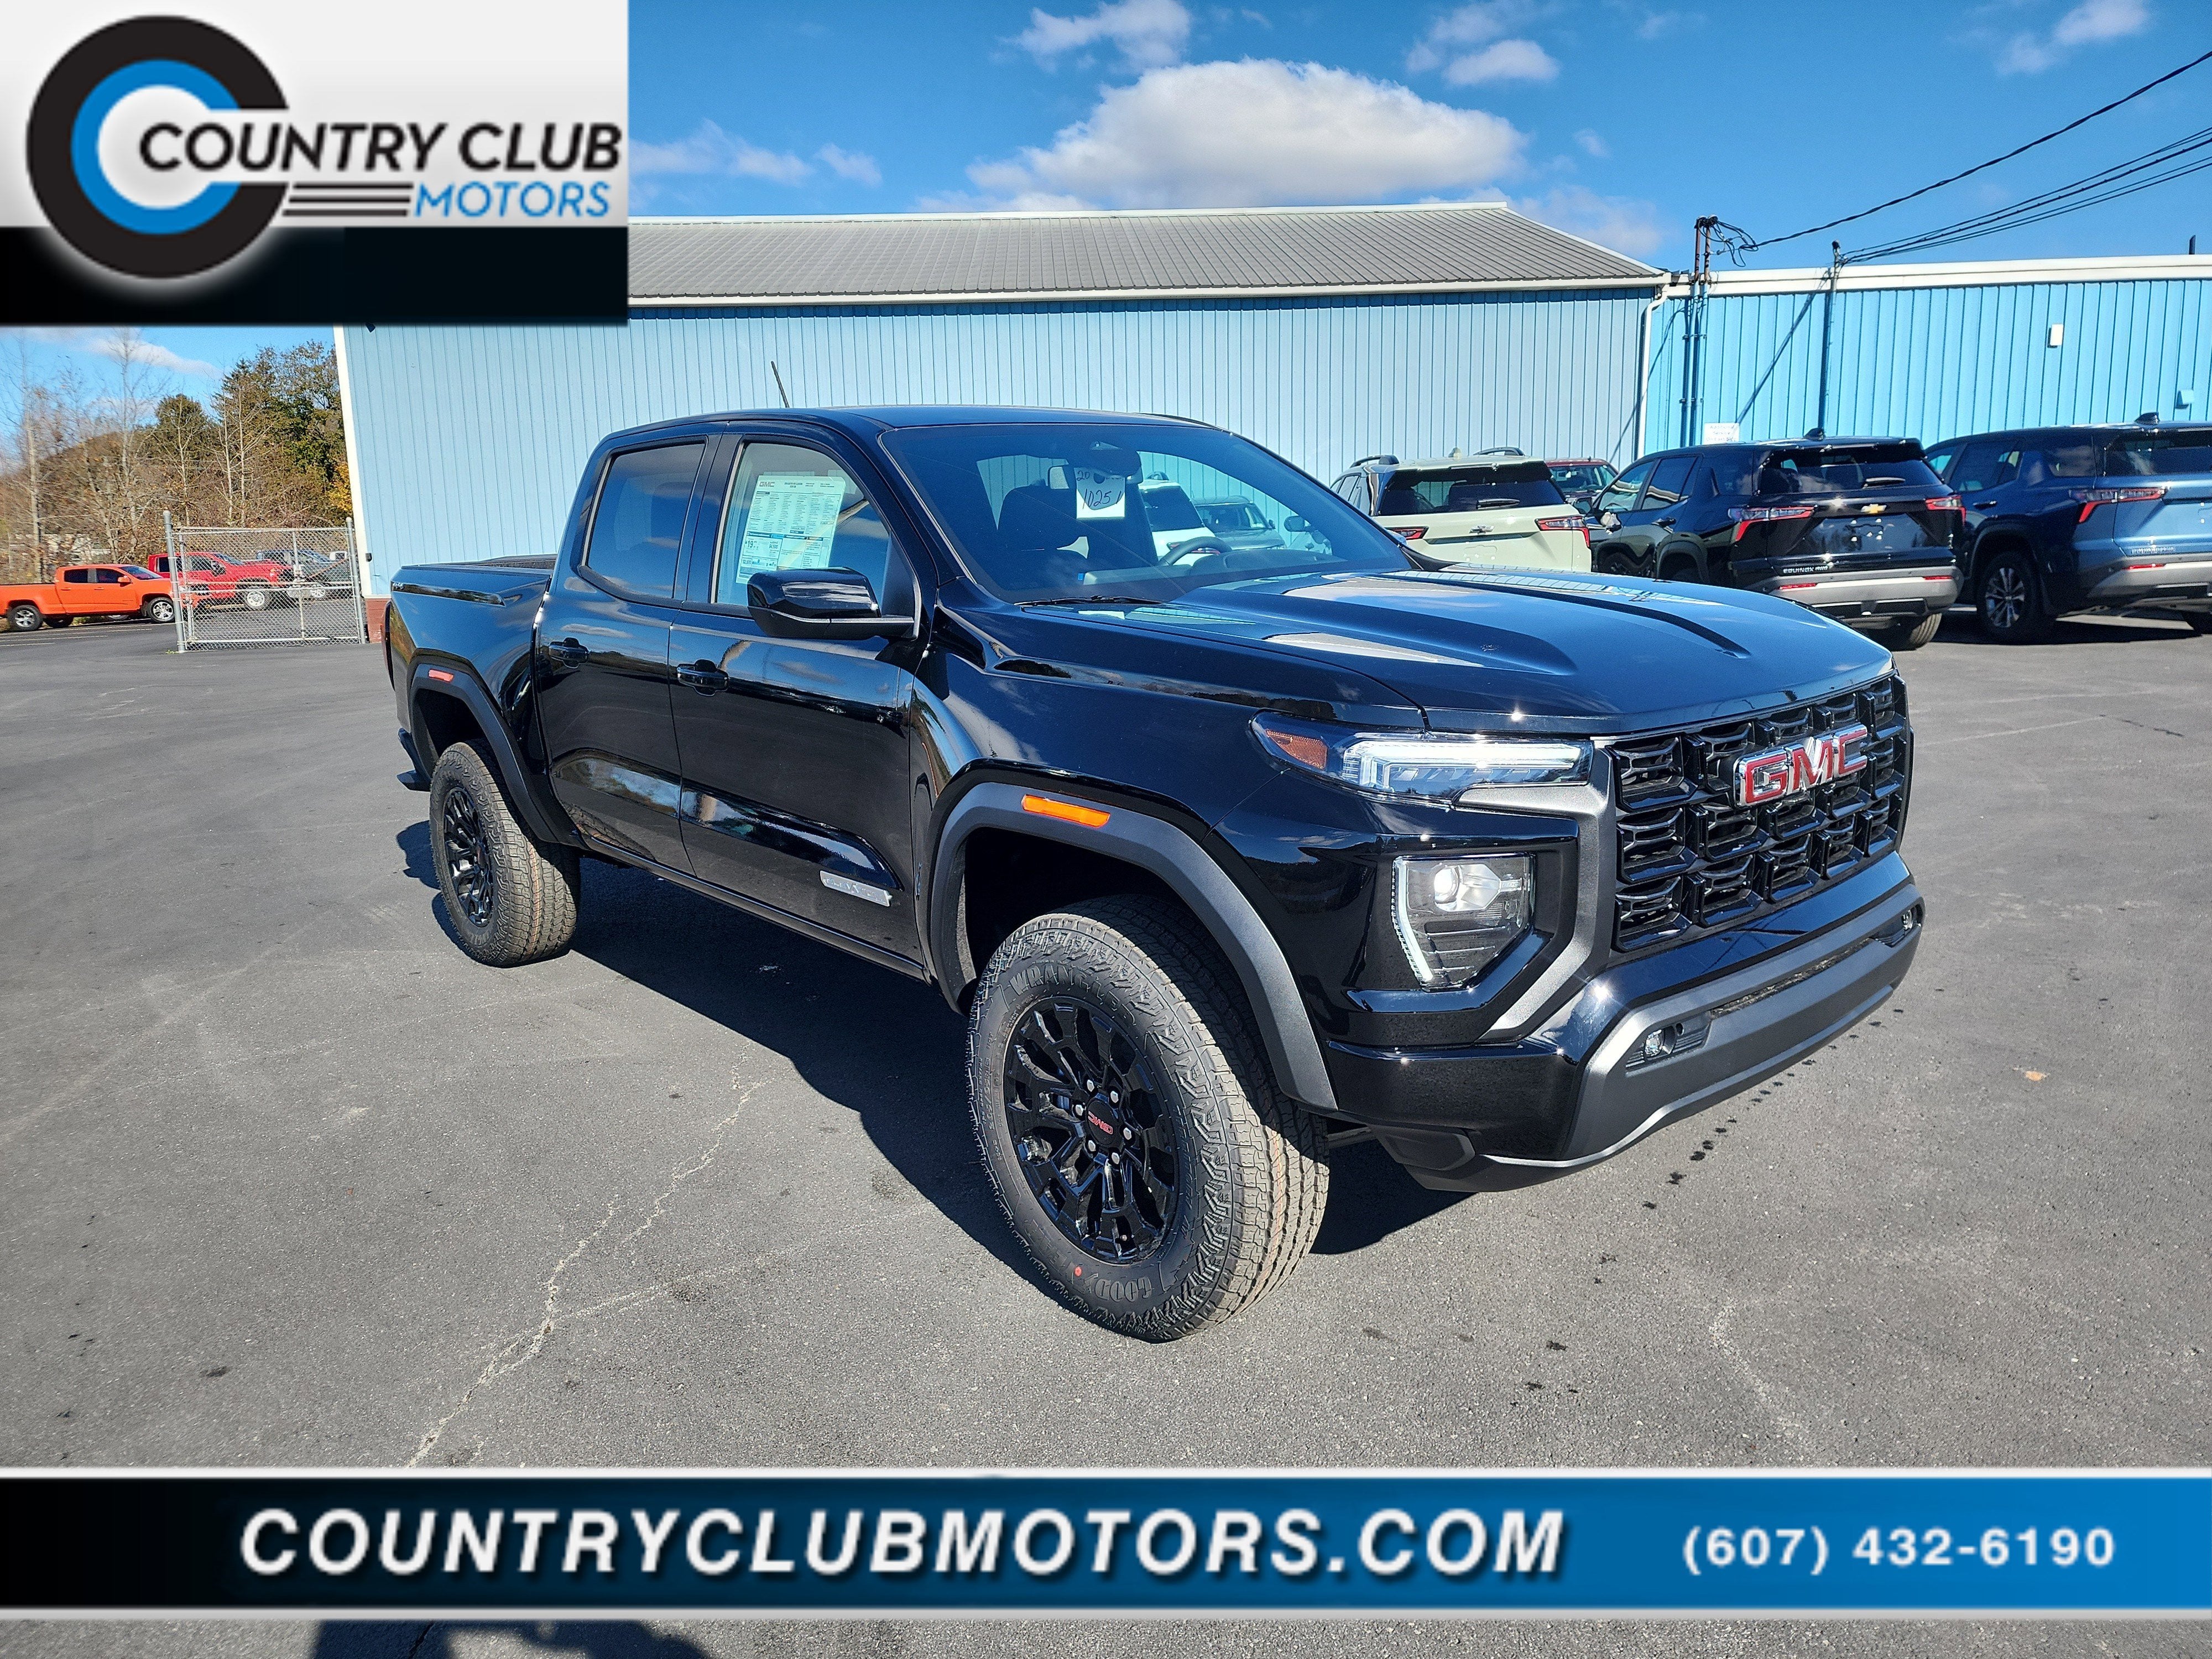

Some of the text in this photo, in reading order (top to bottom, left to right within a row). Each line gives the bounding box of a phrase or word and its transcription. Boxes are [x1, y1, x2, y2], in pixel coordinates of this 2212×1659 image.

[1739, 723, 1868, 806] GMC
[1009, 964, 1137, 1026] WRANGLER
[1088, 1110, 1113, 1134] GMC
